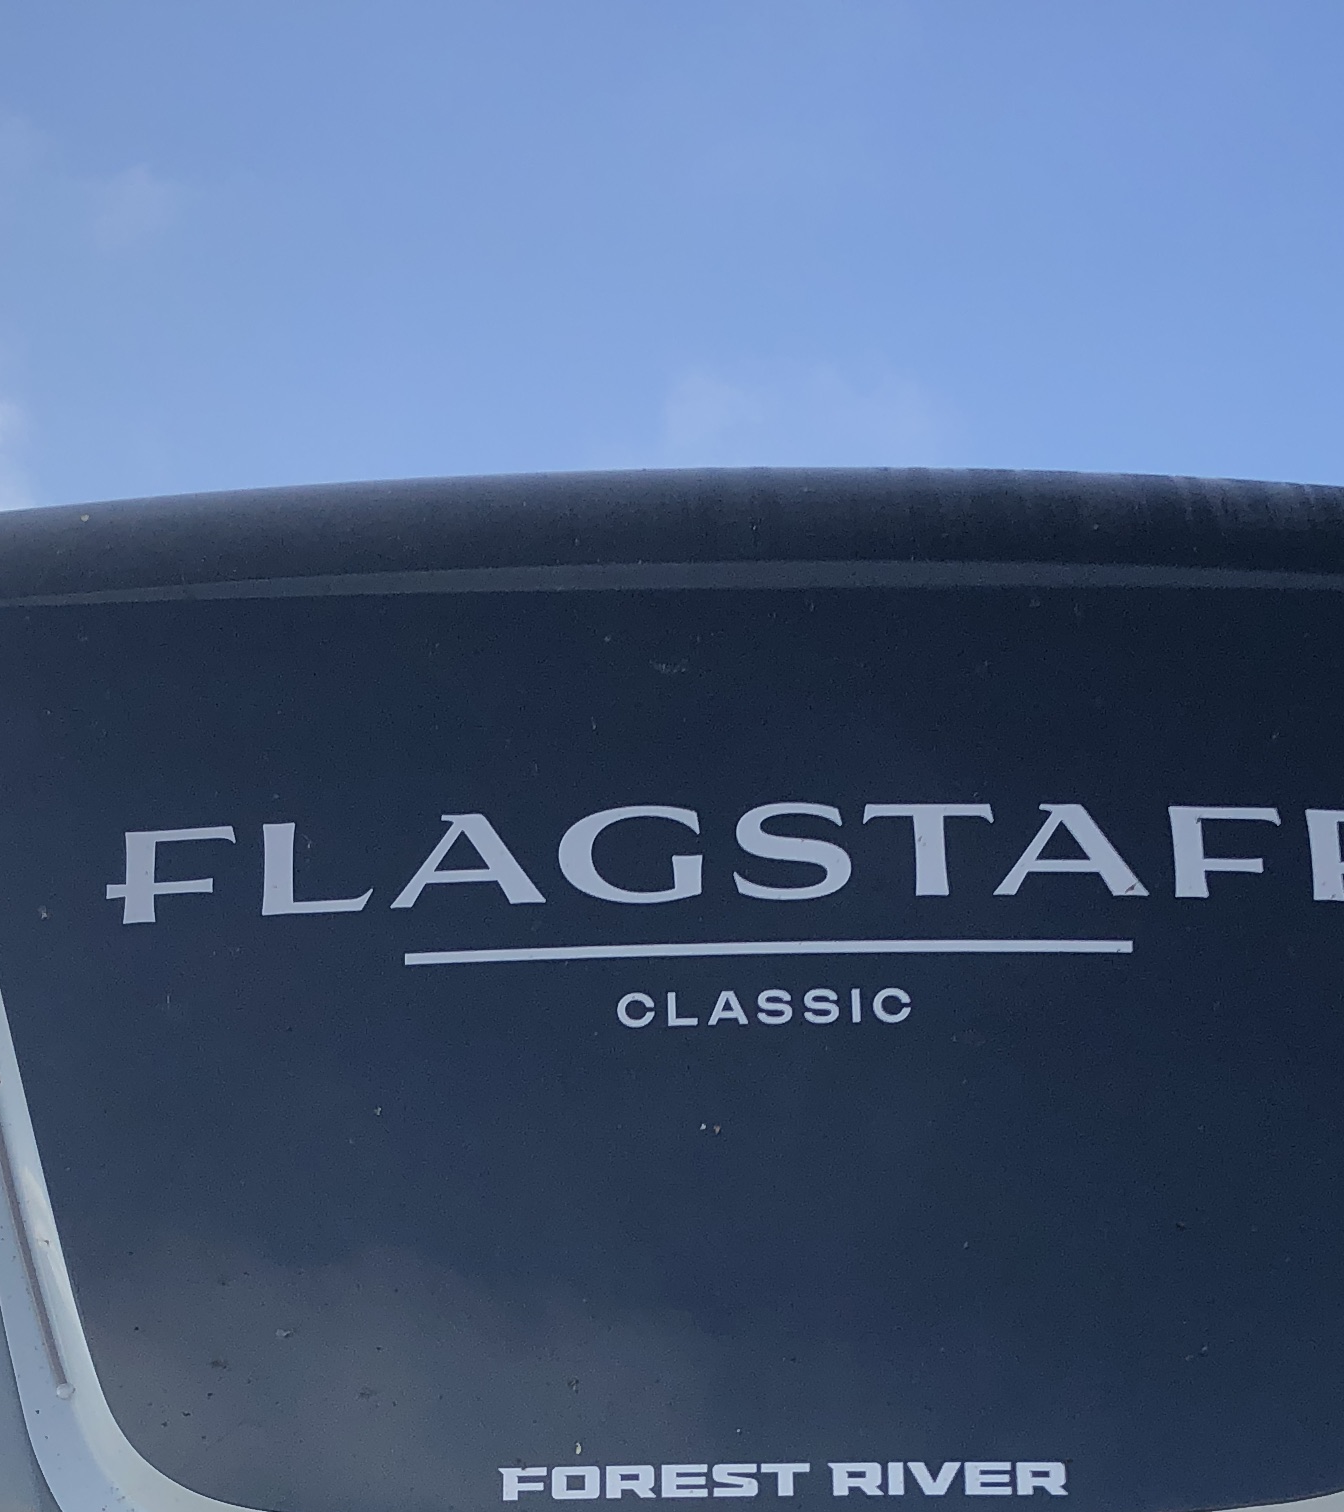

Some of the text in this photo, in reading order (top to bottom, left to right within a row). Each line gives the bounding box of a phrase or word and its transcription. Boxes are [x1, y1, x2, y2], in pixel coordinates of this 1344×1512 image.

[616, 986, 914, 1027] CLASSIC
[501, 1461, 1070, 1501] FOREST RIVER
